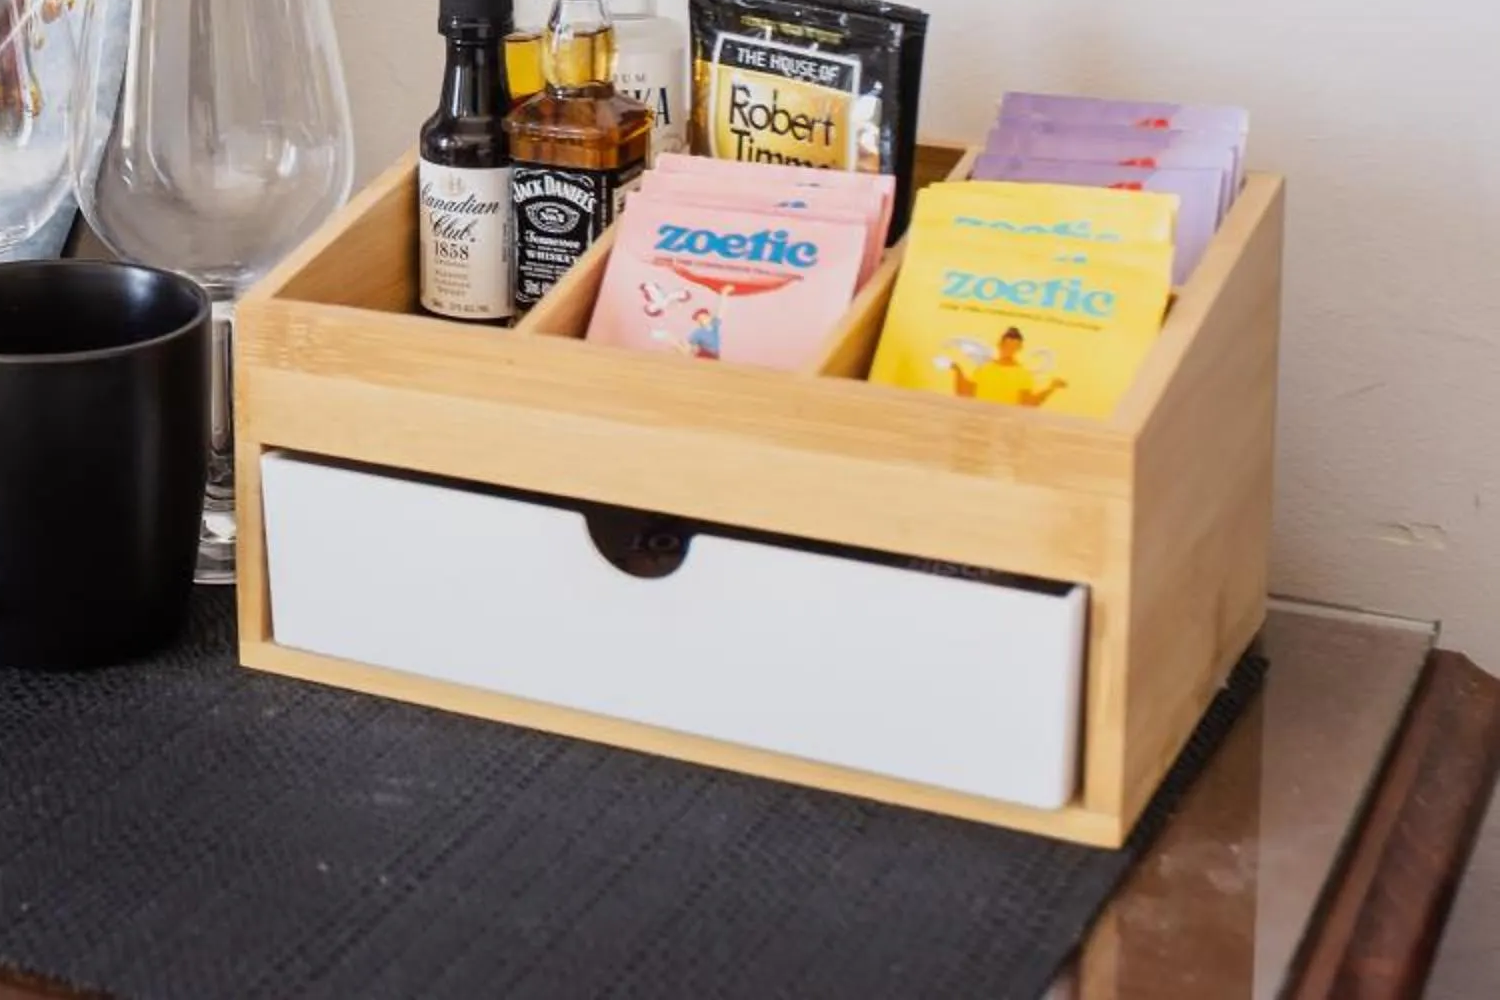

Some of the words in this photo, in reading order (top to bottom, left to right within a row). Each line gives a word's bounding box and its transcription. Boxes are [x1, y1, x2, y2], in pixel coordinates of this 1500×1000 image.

[736, 48, 768, 68] THE
[769, 54, 818, 80] HOUSE
[817, 65, 841, 82] OF
[730, 83, 835, 146] Robert
[420, 183, 500, 215] Canadian
[512, 180, 545, 203] JACK
[434, 240, 470, 261] 1858
[653, 224, 819, 270] zoetic
[941, 269, 1117, 319] zoetic
